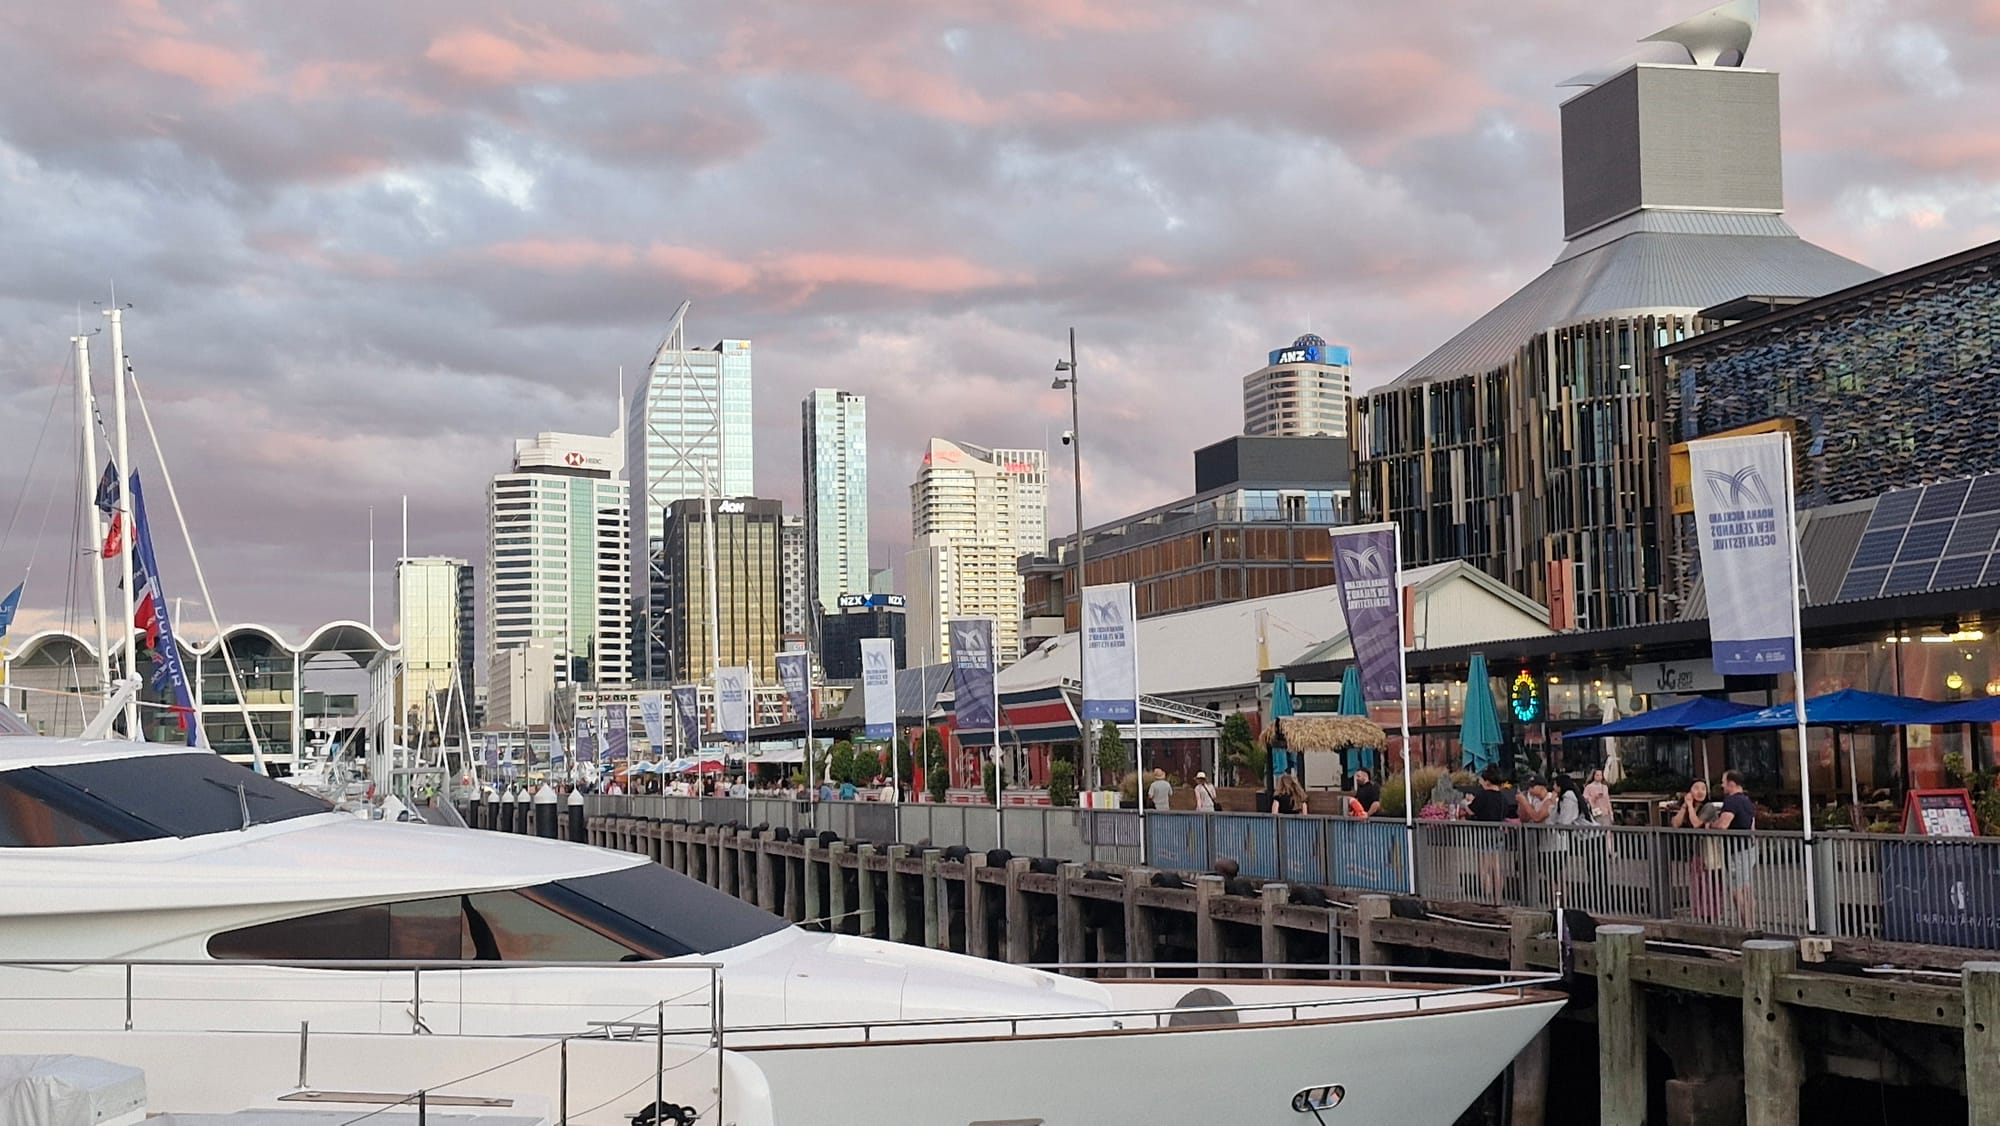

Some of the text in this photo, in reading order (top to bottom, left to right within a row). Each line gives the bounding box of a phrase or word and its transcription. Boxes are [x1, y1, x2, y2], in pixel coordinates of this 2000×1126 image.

[1279, 350, 1305, 364] ANZ
[840, 596, 862, 606] NZX
[888, 595, 903, 606] NZX
